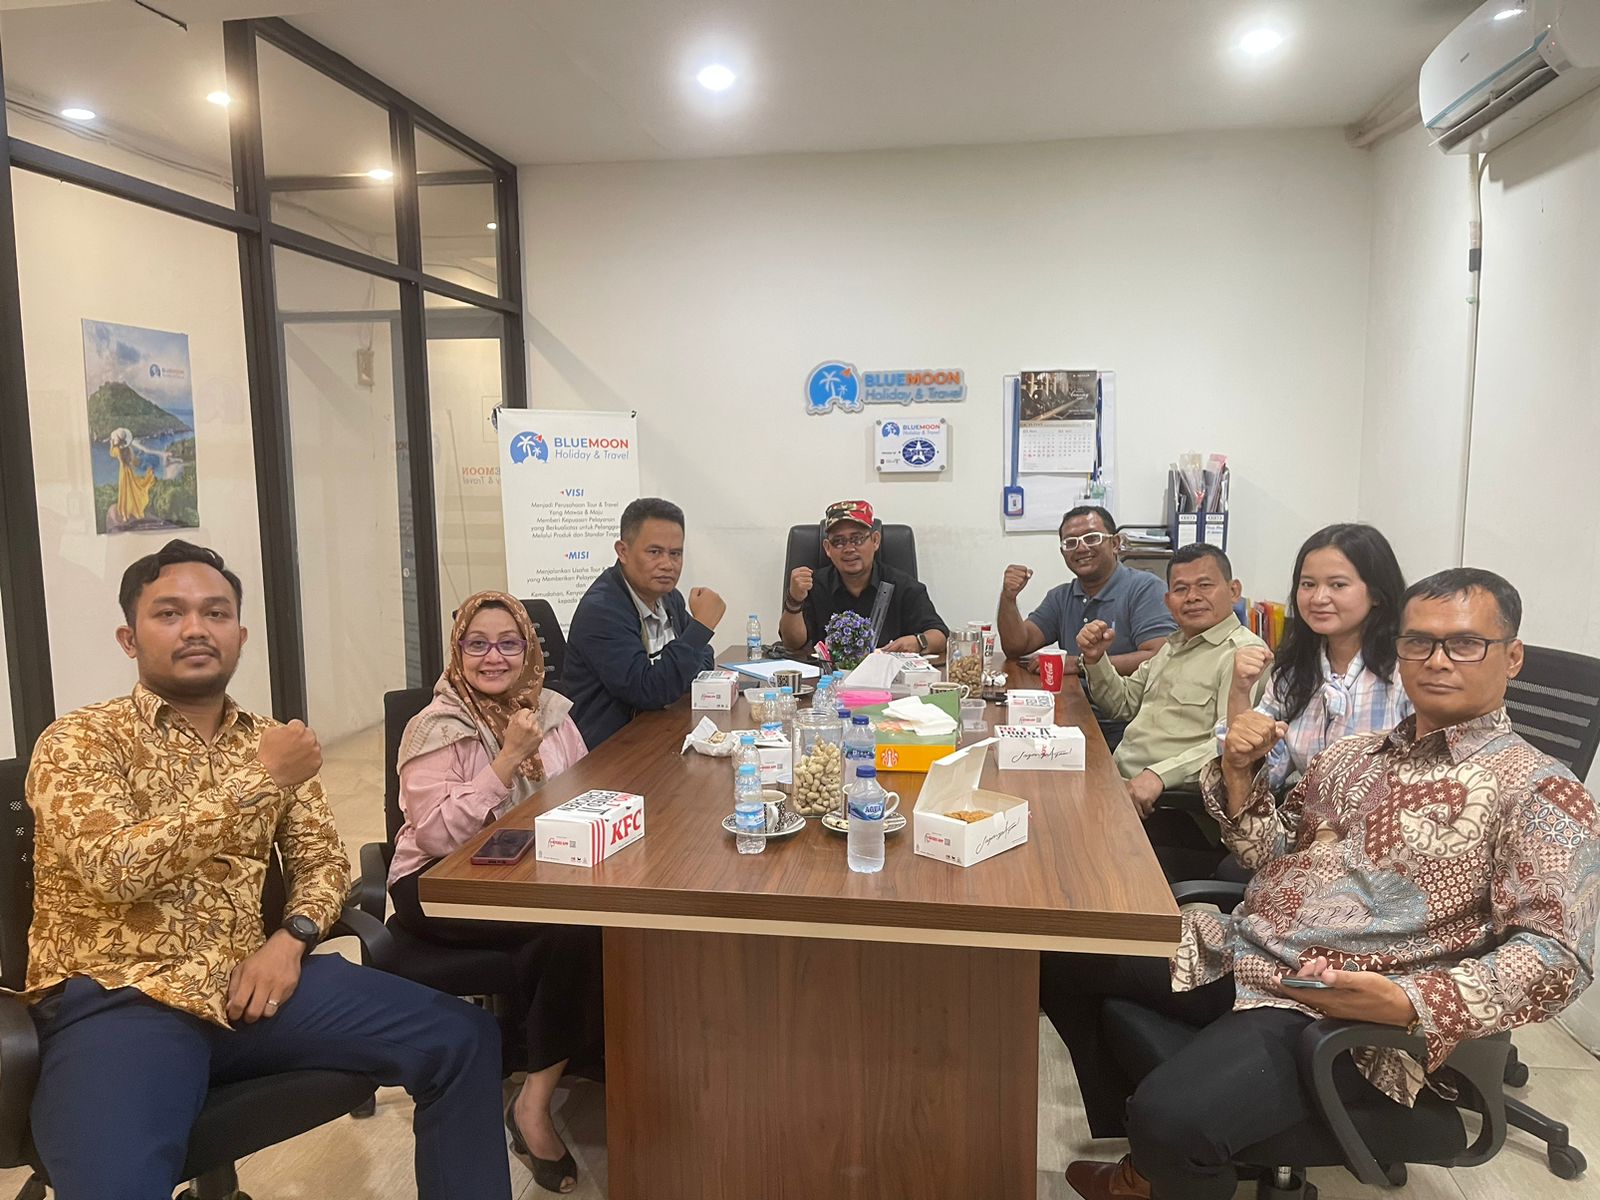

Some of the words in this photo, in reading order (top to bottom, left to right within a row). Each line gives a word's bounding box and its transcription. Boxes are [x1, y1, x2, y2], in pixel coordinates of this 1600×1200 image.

[865, 371, 960, 387] BLUEMOON
[865, 387, 911, 402] Holiday
[914, 388, 923, 399] &
[928, 385, 963, 399] Travel
[554, 437, 629, 449] BLUEMOON
[555, 449, 591, 461] Holiday
[594, 450, 600, 459] &
[604, 450, 629, 460] Travel
[565, 488, 584, 497] VISI
[568, 551, 589, 560] MISI
[864, 804, 882, 813] AQUA
[610, 808, 642, 846] KFC
